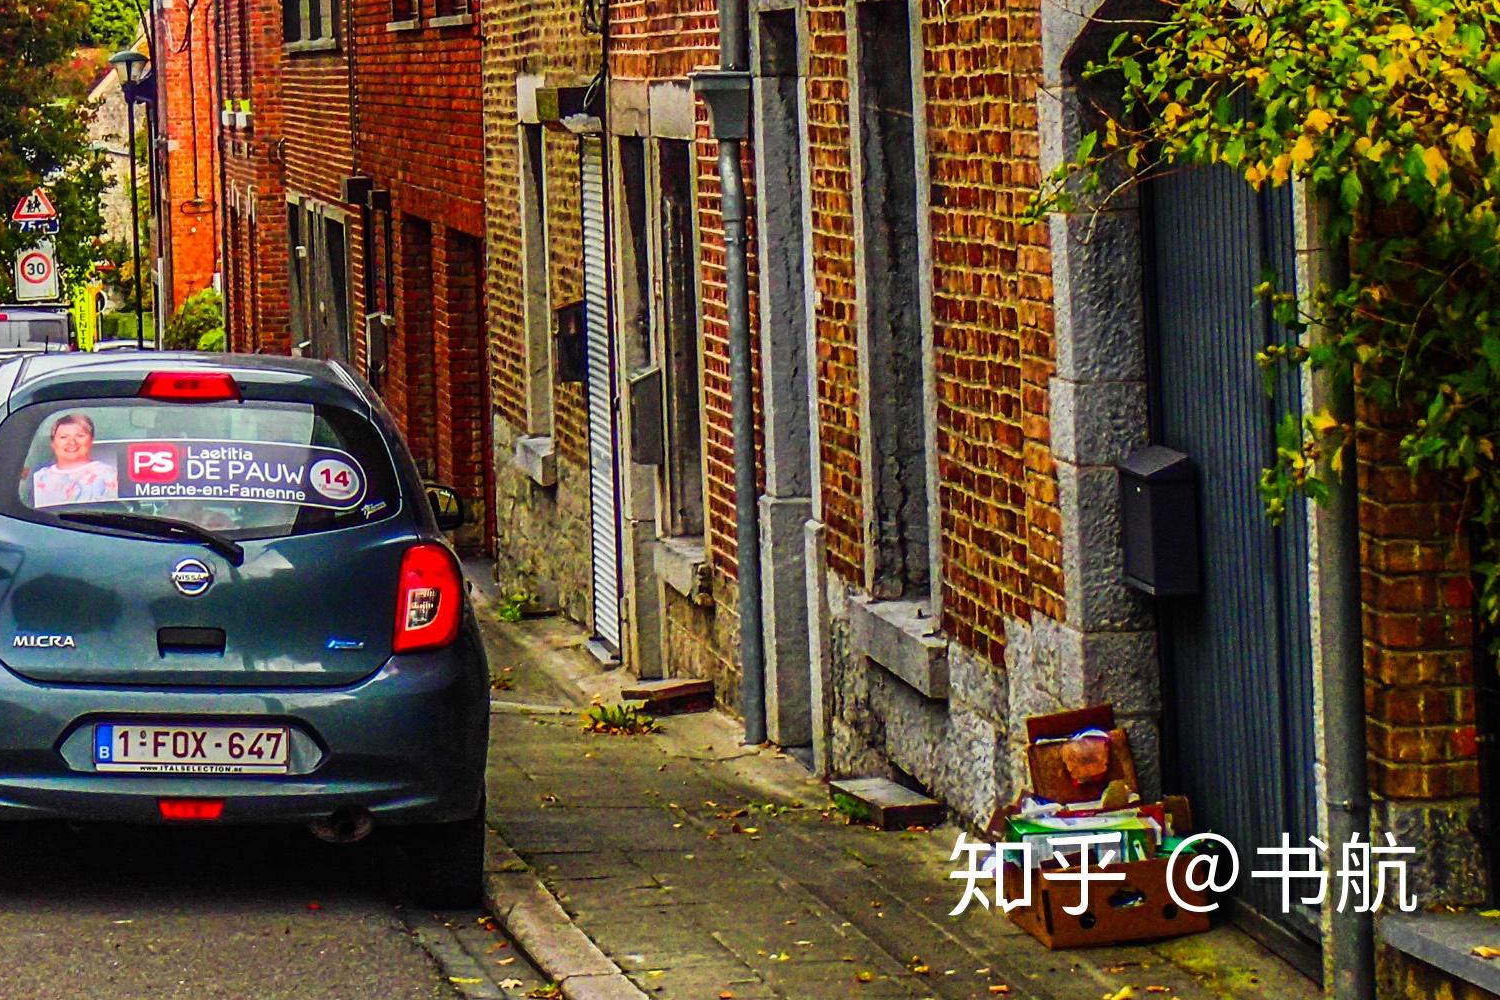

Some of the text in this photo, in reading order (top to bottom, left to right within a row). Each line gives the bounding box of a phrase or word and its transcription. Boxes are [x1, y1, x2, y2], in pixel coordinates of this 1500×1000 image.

[26, 262, 45, 276] 30
[187, 446, 253, 461] Laetitia
[133, 450, 175, 475] PS
[186, 460, 304, 485] DE PAUW
[319, 468, 350, 487] 14
[135, 482, 306, 502] Marche-en-Famenne
[13, 635, 77, 648] MICRA
[99, 745, 110, 760] B
